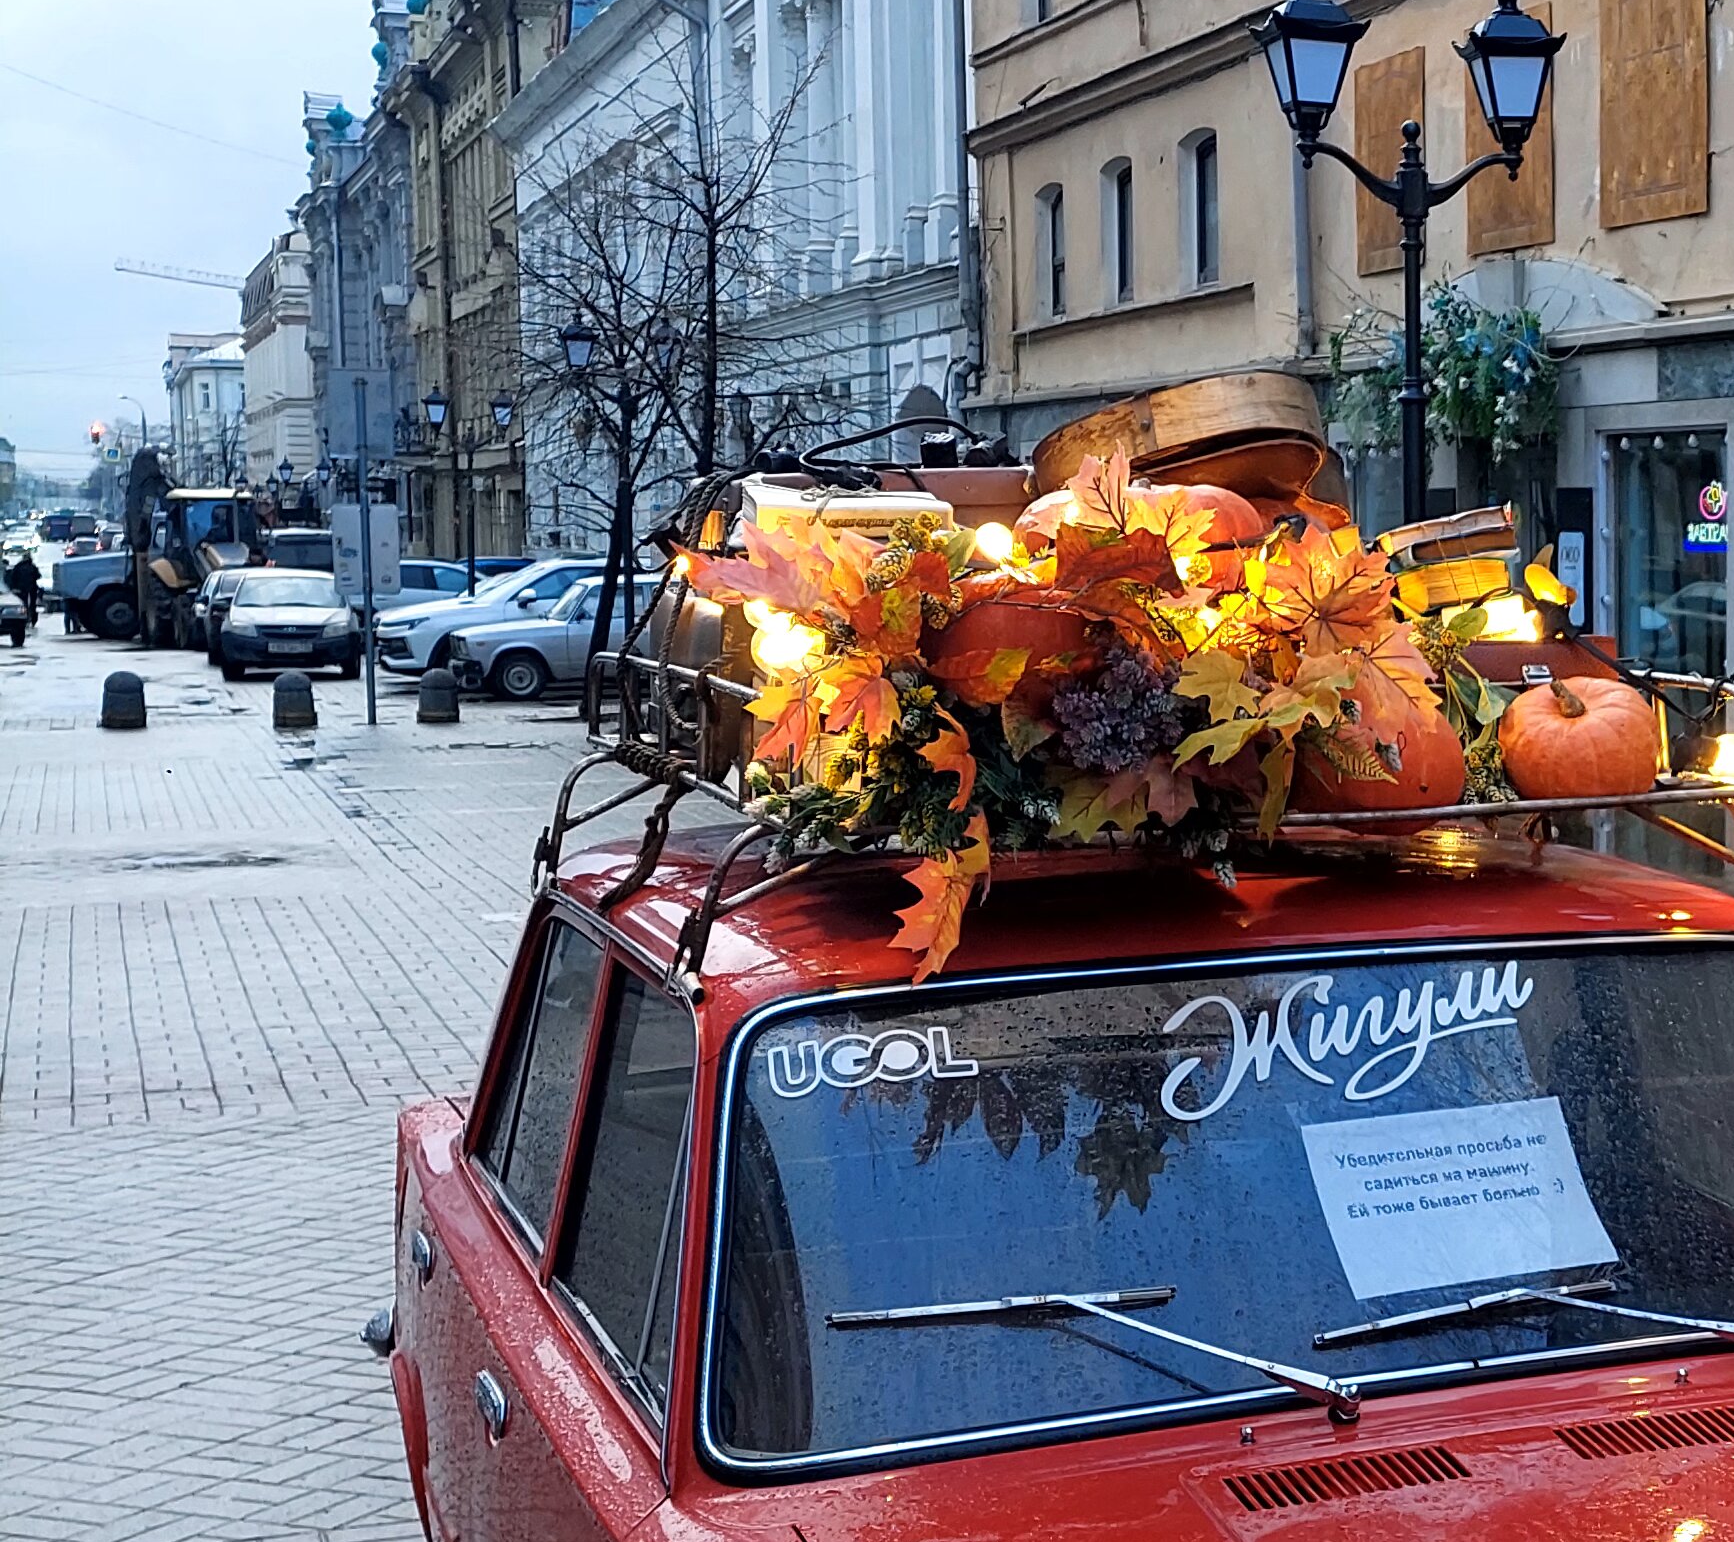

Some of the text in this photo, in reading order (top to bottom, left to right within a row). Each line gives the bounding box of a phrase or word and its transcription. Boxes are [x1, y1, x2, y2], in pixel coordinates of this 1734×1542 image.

[1160, 959, 1534, 1122] Жигули
[767, 1026, 979, 1098] UGOL
[1334, 1133, 1547, 1170] Убедительная просьба не
[1363, 1171, 1439, 1192] садиться
[1443, 1169, 1462, 1183] на
[1347, 1202, 1370, 1219] Ей
[1373, 1199, 1415, 1215] тоже
[1419, 1191, 1479, 1212] бывает
[1483, 1184, 1541, 1202] больно
